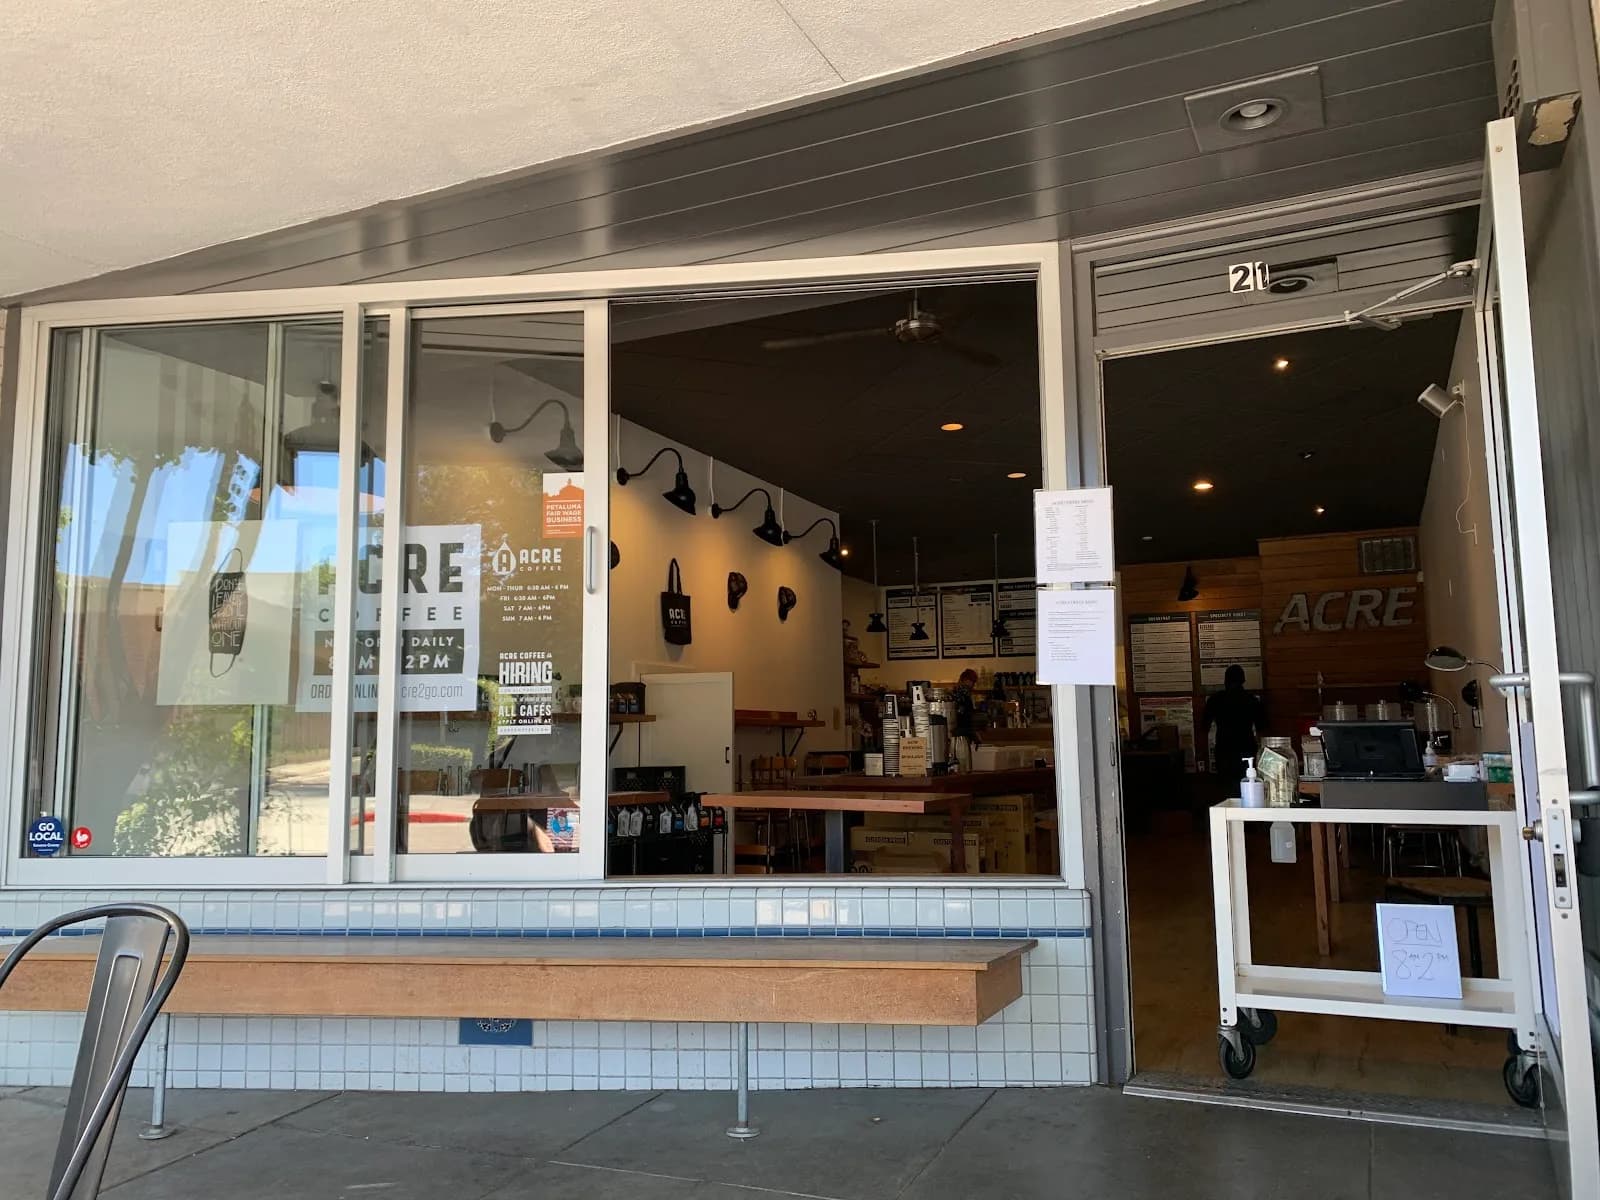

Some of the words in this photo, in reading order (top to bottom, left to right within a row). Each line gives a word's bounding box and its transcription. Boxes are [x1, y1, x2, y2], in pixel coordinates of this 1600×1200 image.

[520, 548, 562, 564] ACRE
[319, 606, 462, 622] CFFEE
[1273, 587, 1417, 632] ACRE
[212, 631, 241, 647] ONE
[412, 637, 454, 648] DAILY
[405, 655, 449, 669] 2PM
[500, 652, 518, 660] ACRE
[499, 661, 552, 684] HIRING
[354, 684, 378, 698] NLIN
[402, 683, 463, 700] cre2go.com
[498, 706, 516, 717] ALL
[520, 703, 552, 717] CAFÉS
[39, 823, 55, 831] GO
[30, 832, 64, 841] LOCAL
[1386, 917, 1442, 944] OPEN
